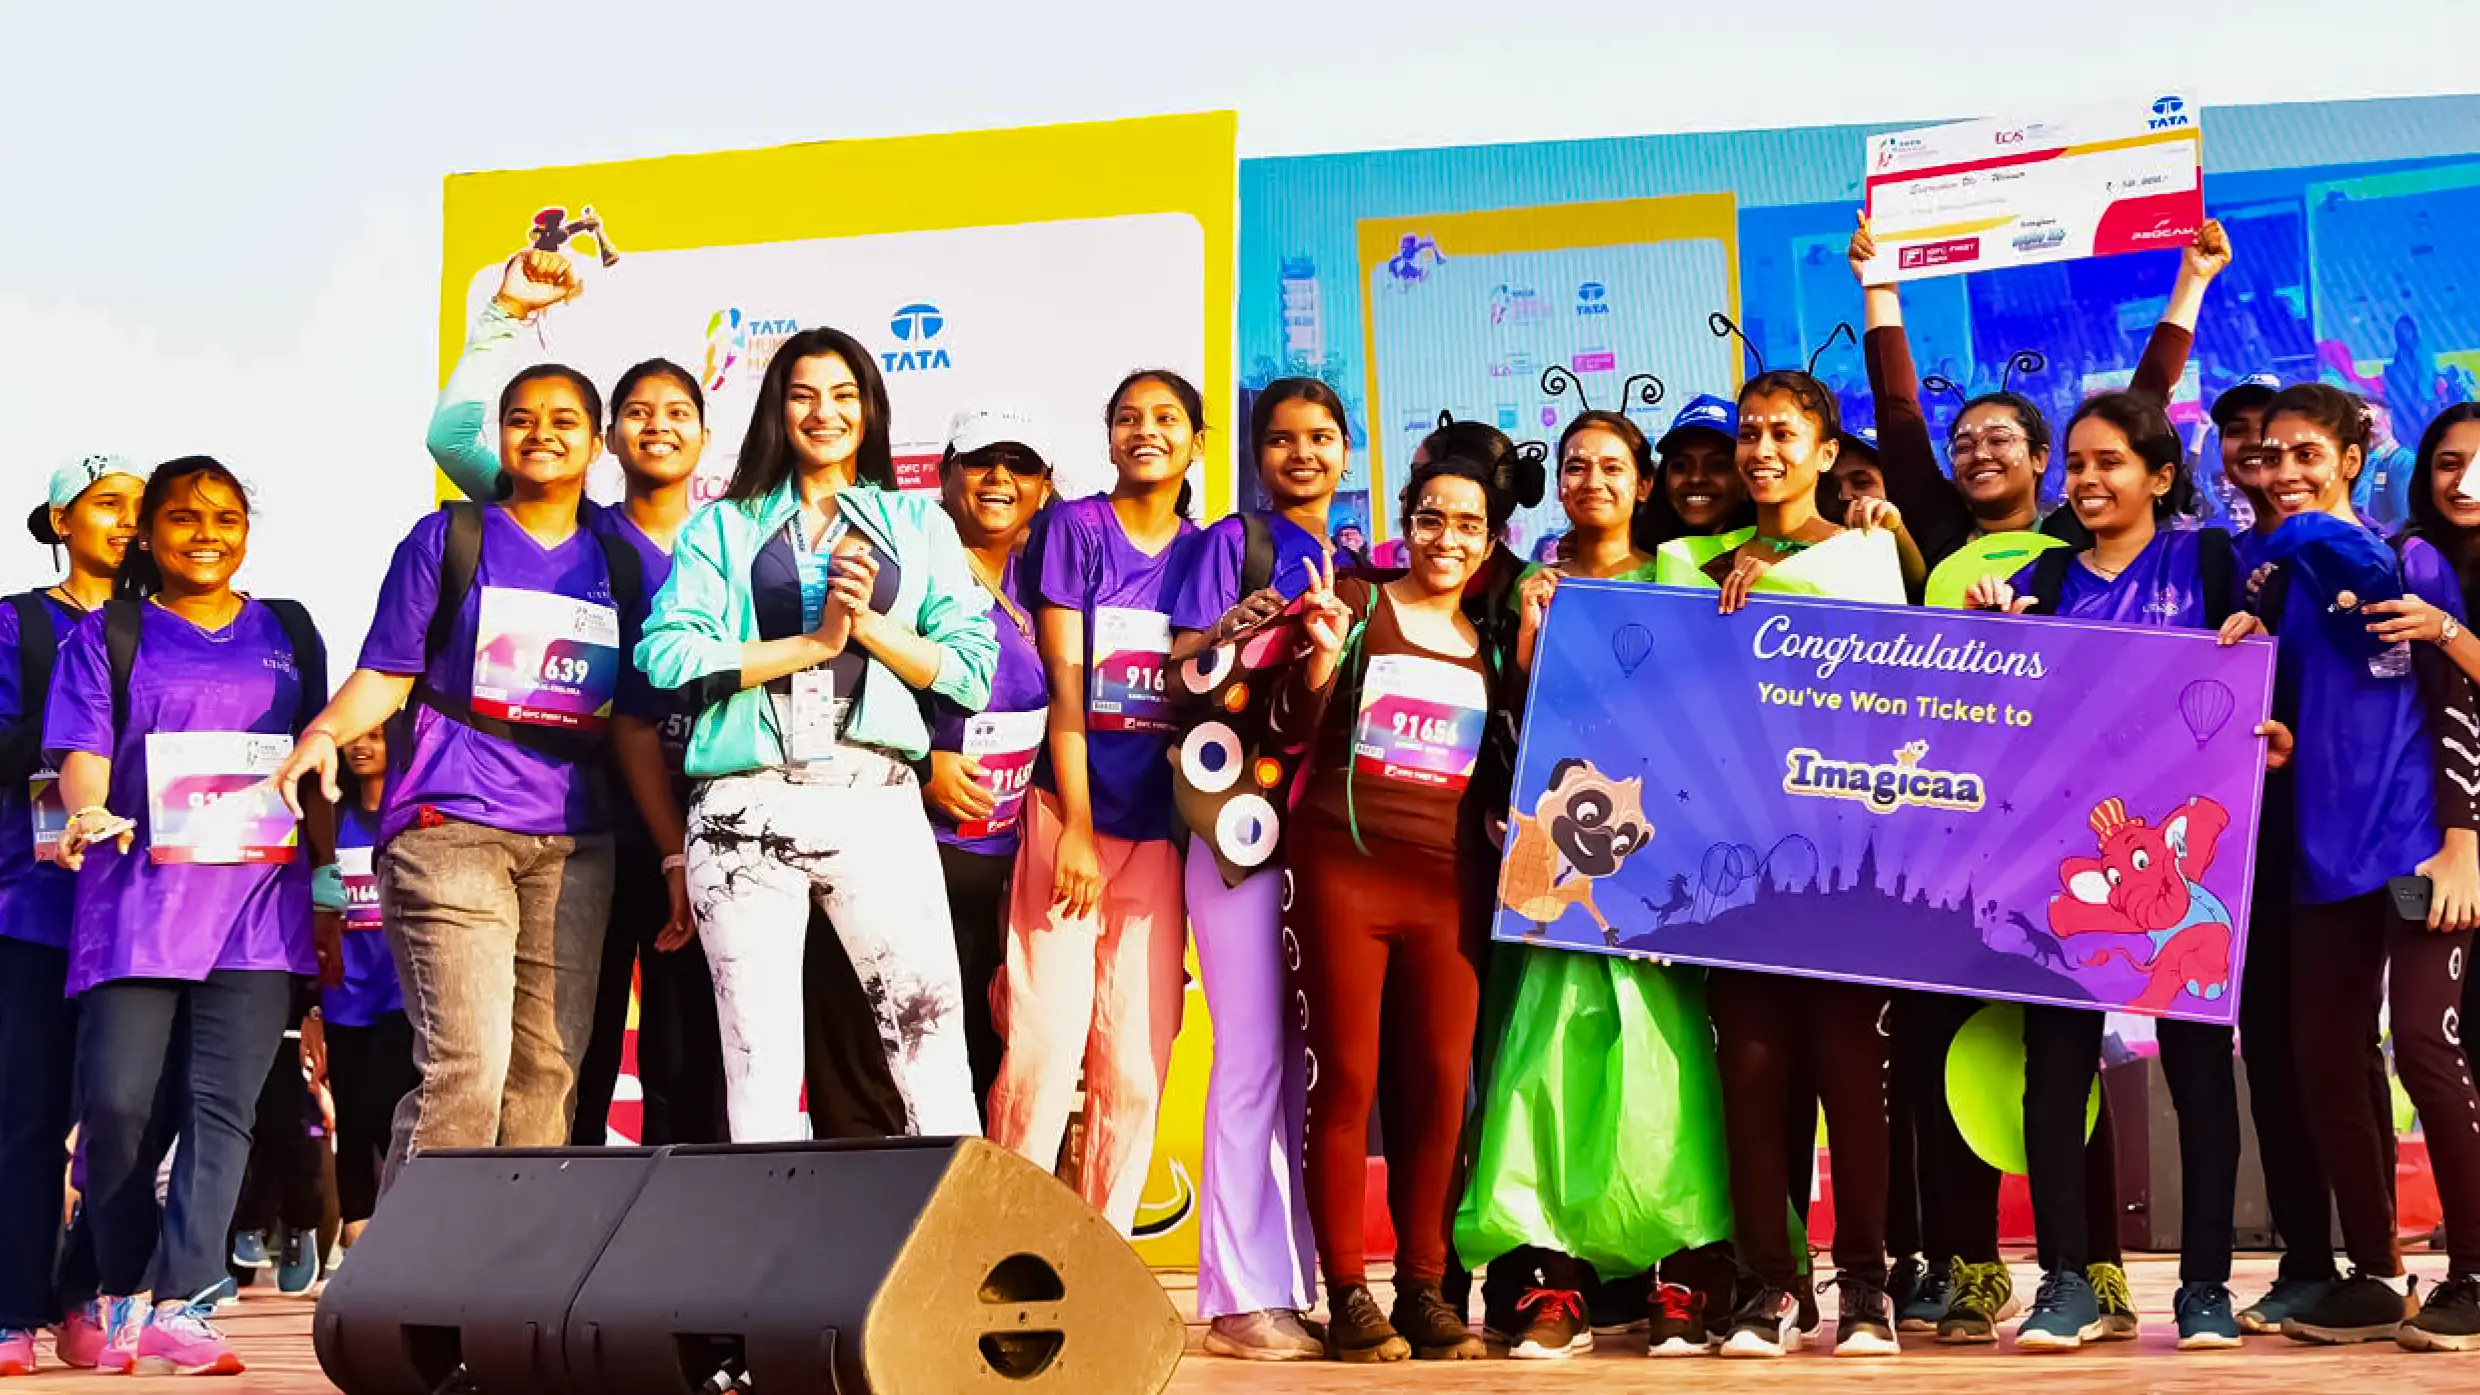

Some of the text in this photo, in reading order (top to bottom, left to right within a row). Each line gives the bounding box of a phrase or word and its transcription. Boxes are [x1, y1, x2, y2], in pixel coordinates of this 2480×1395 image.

[2147, 115, 2188, 129] TATA
[1576, 303, 1610, 316] TATA
[748, 319, 798, 336] TATA
[881, 350, 952, 373] TATA
[1753, 615, 2047, 679] Congratulations
[1758, 682, 2033, 727] You've Won Ticket to
[1392, 711, 1458, 746] 91656
[1790, 753, 1980, 805] Imagicaa
